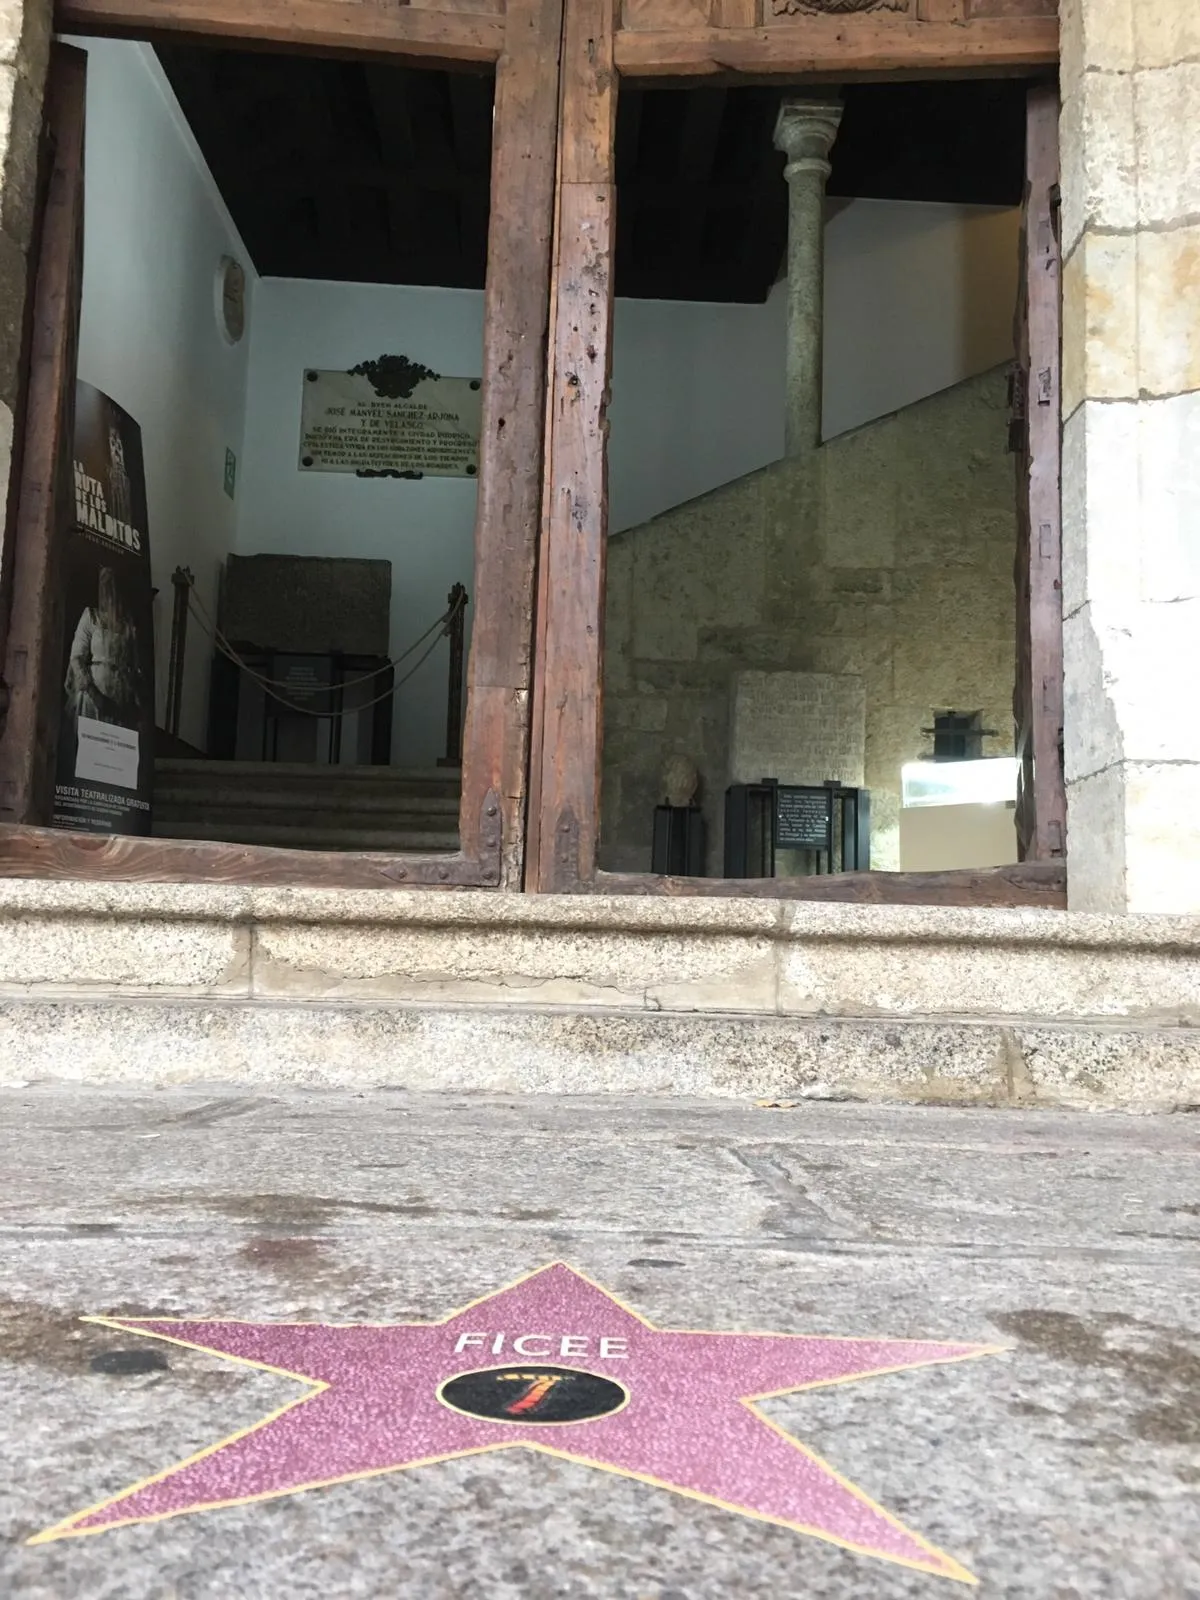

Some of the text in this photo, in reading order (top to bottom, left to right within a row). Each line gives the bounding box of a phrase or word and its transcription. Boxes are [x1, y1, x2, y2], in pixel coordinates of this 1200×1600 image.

[369, 419, 380, 428] DE
[74, 459, 84, 474] LA
[75, 470, 104, 500] RUTA
[76, 487, 107, 513] DE LOS
[76, 501, 140, 551] MALDITOS
[55, 785, 80, 797] VISITA
[81, 788, 125, 805] TEATRALIZADA
[453, 1331, 630, 1359] FICEE
